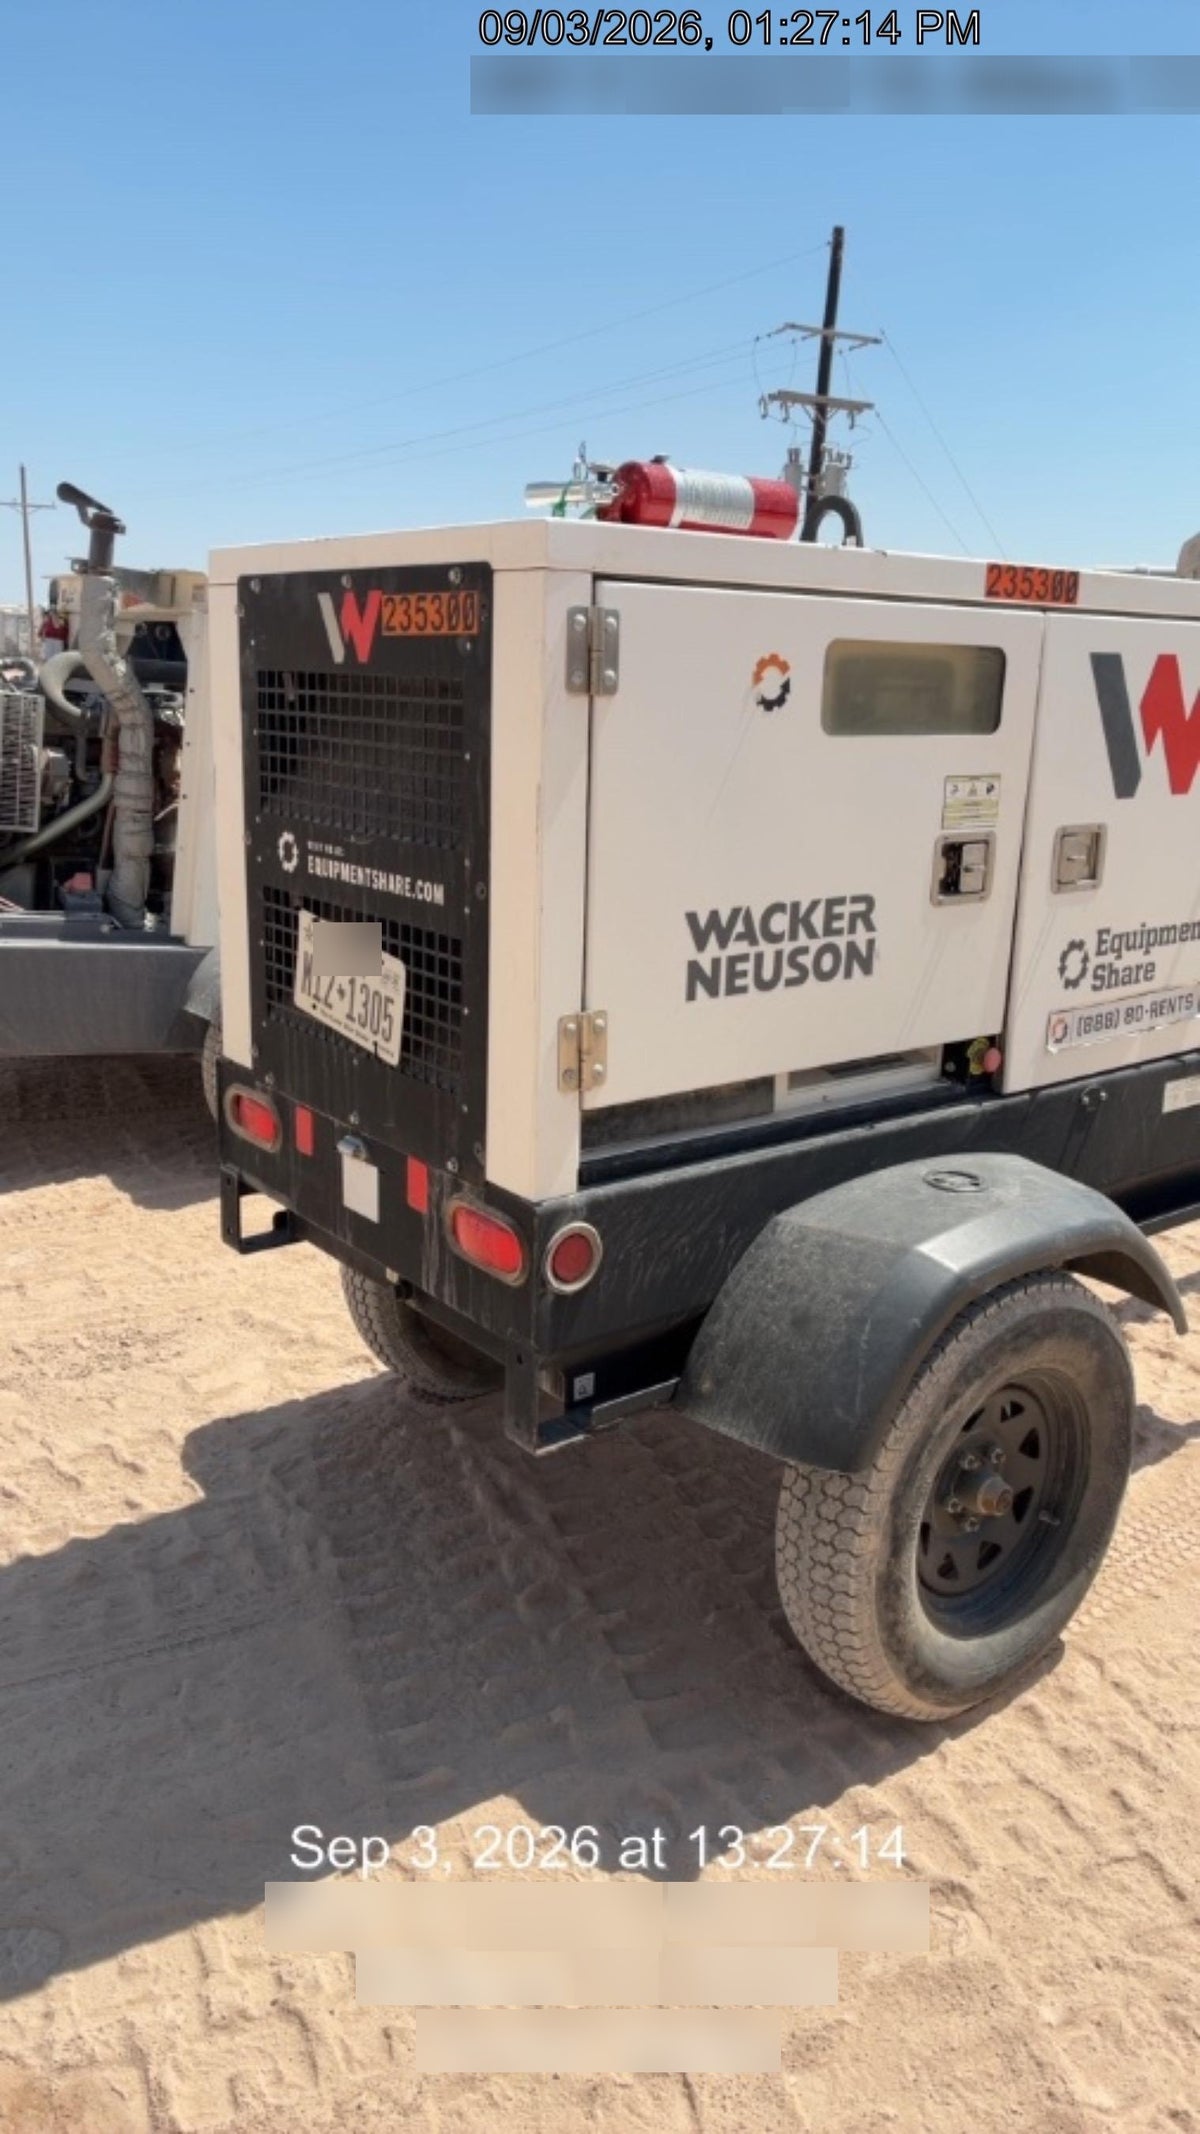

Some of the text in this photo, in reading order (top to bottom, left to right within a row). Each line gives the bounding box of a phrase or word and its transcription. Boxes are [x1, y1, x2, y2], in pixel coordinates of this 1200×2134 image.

[986, 563, 1079, 605] 235300
[383, 593, 476, 632] 235300
[307, 855, 444, 906] EQUIPMENTSHARE.COM
[685, 893, 877, 953] WACKER
[685, 937, 876, 1003] NEUSON
[1091, 961, 1156, 992] Share
